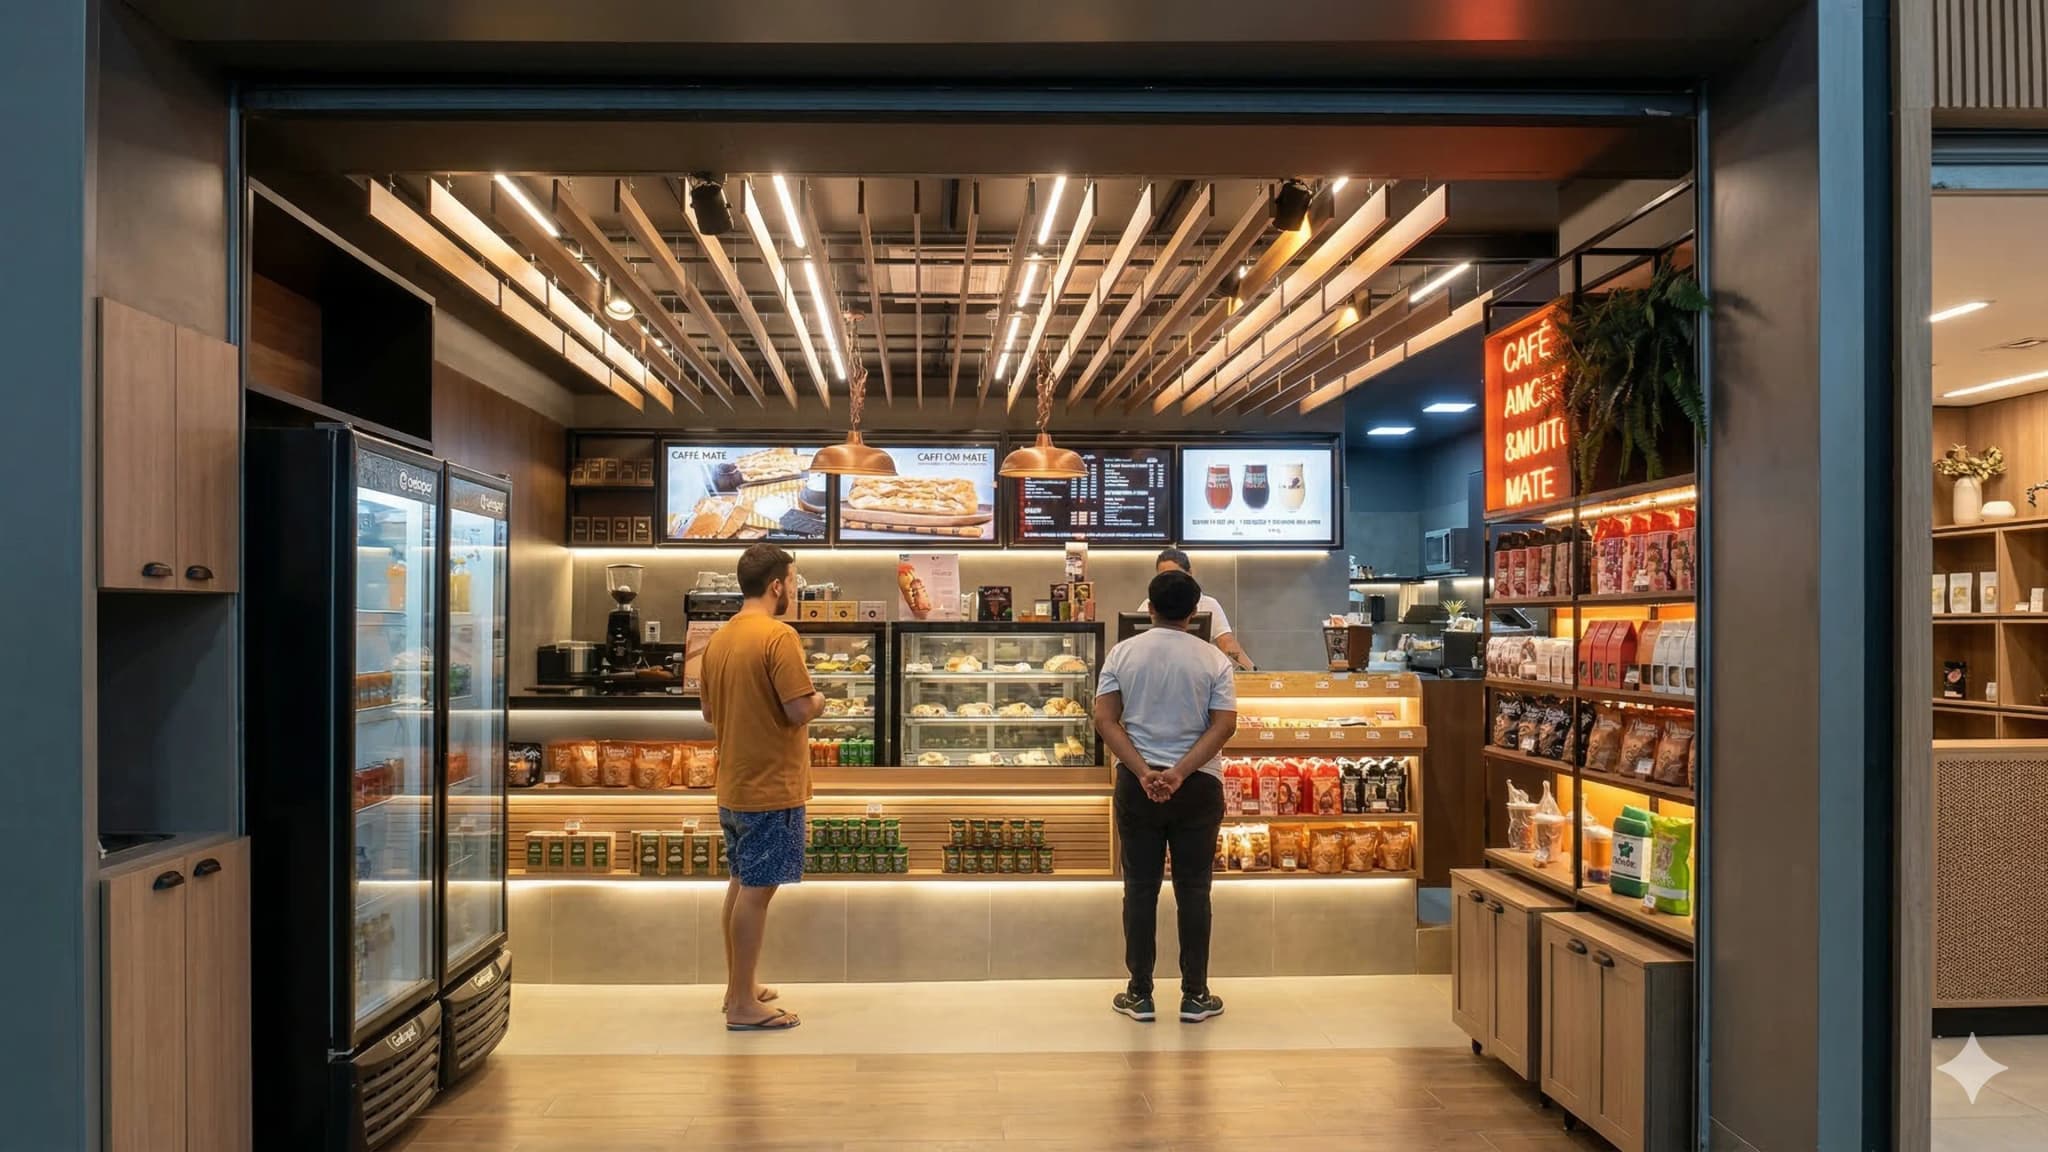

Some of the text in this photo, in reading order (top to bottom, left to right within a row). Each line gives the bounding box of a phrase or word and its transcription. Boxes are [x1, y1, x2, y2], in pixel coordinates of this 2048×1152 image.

[1503, 319, 1552, 373] CAFÉ
[701, 450, 728, 460] MATE
[963, 452, 988, 462] MATE
[1505, 467, 1555, 506] MATE
